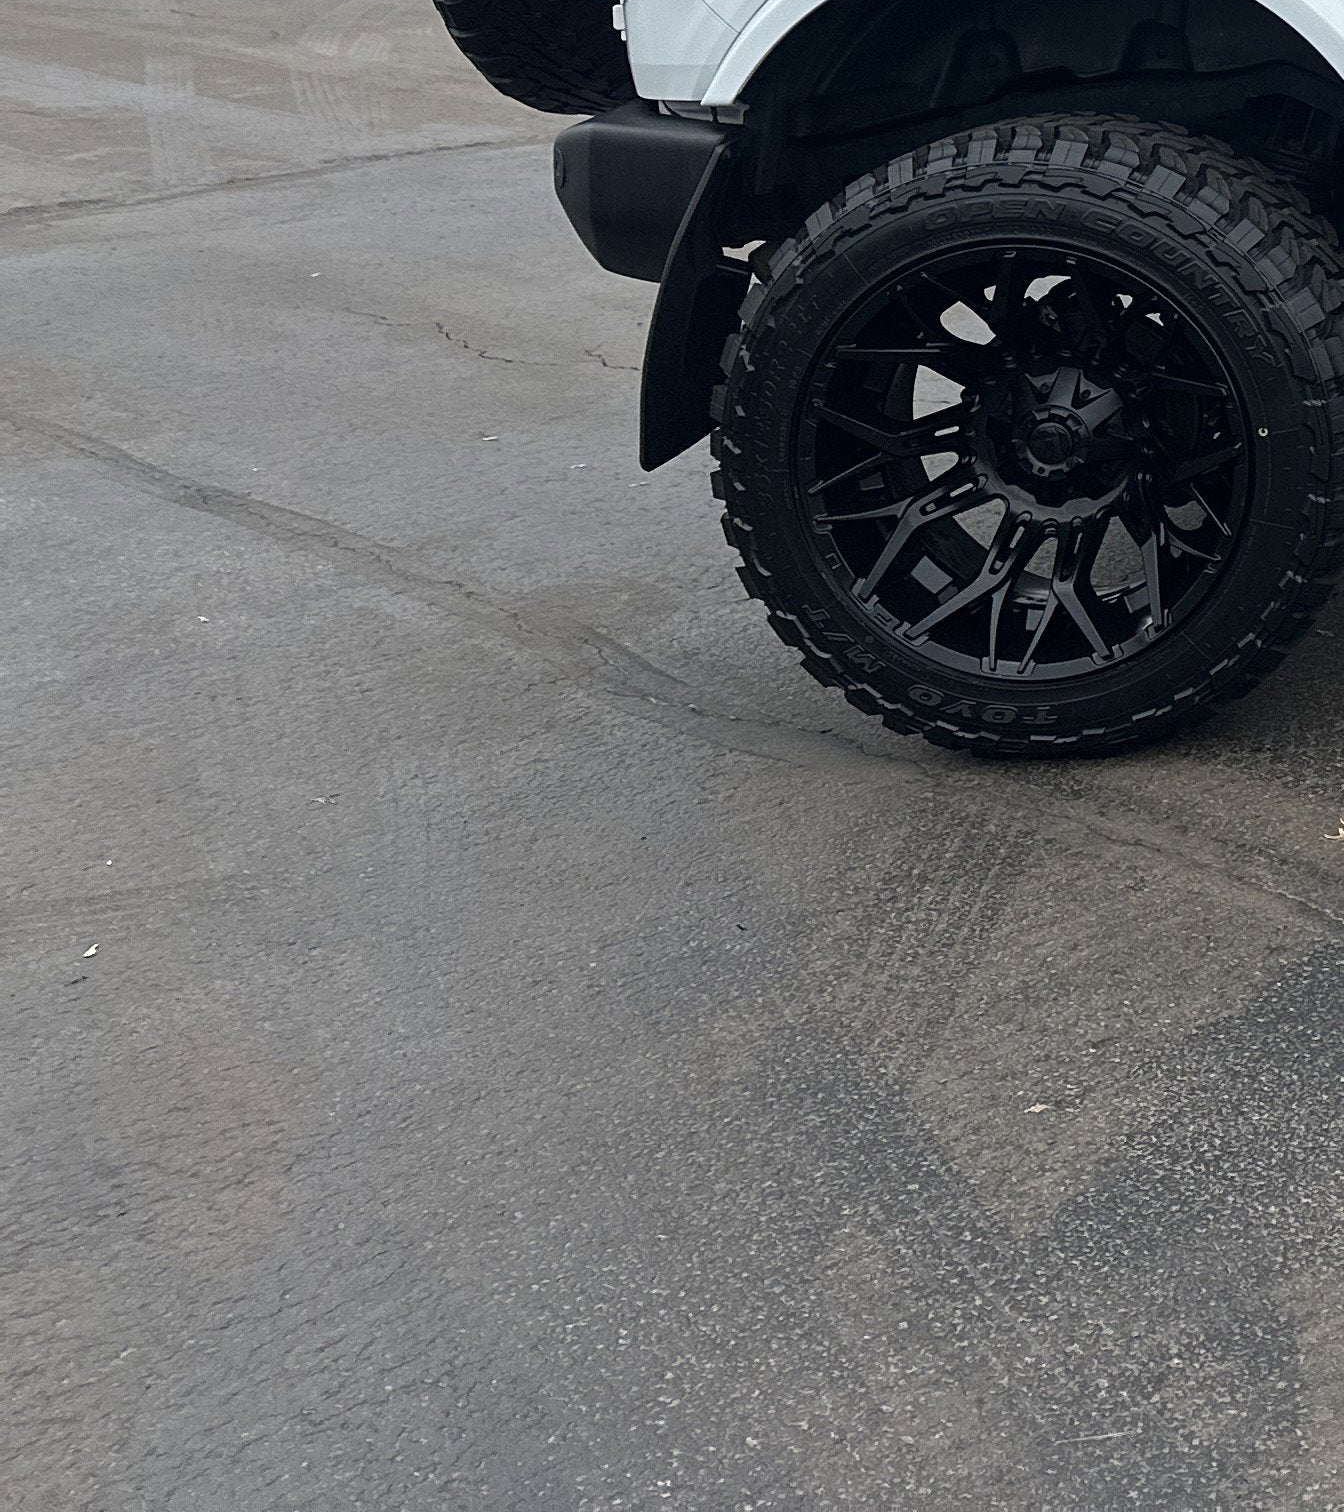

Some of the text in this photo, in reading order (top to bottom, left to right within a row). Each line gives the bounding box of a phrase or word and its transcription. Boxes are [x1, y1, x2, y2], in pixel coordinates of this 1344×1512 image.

[925, 198, 1282, 368] OPEN COUNTRY
[801, 603, 1058, 725] TOYO M/T
